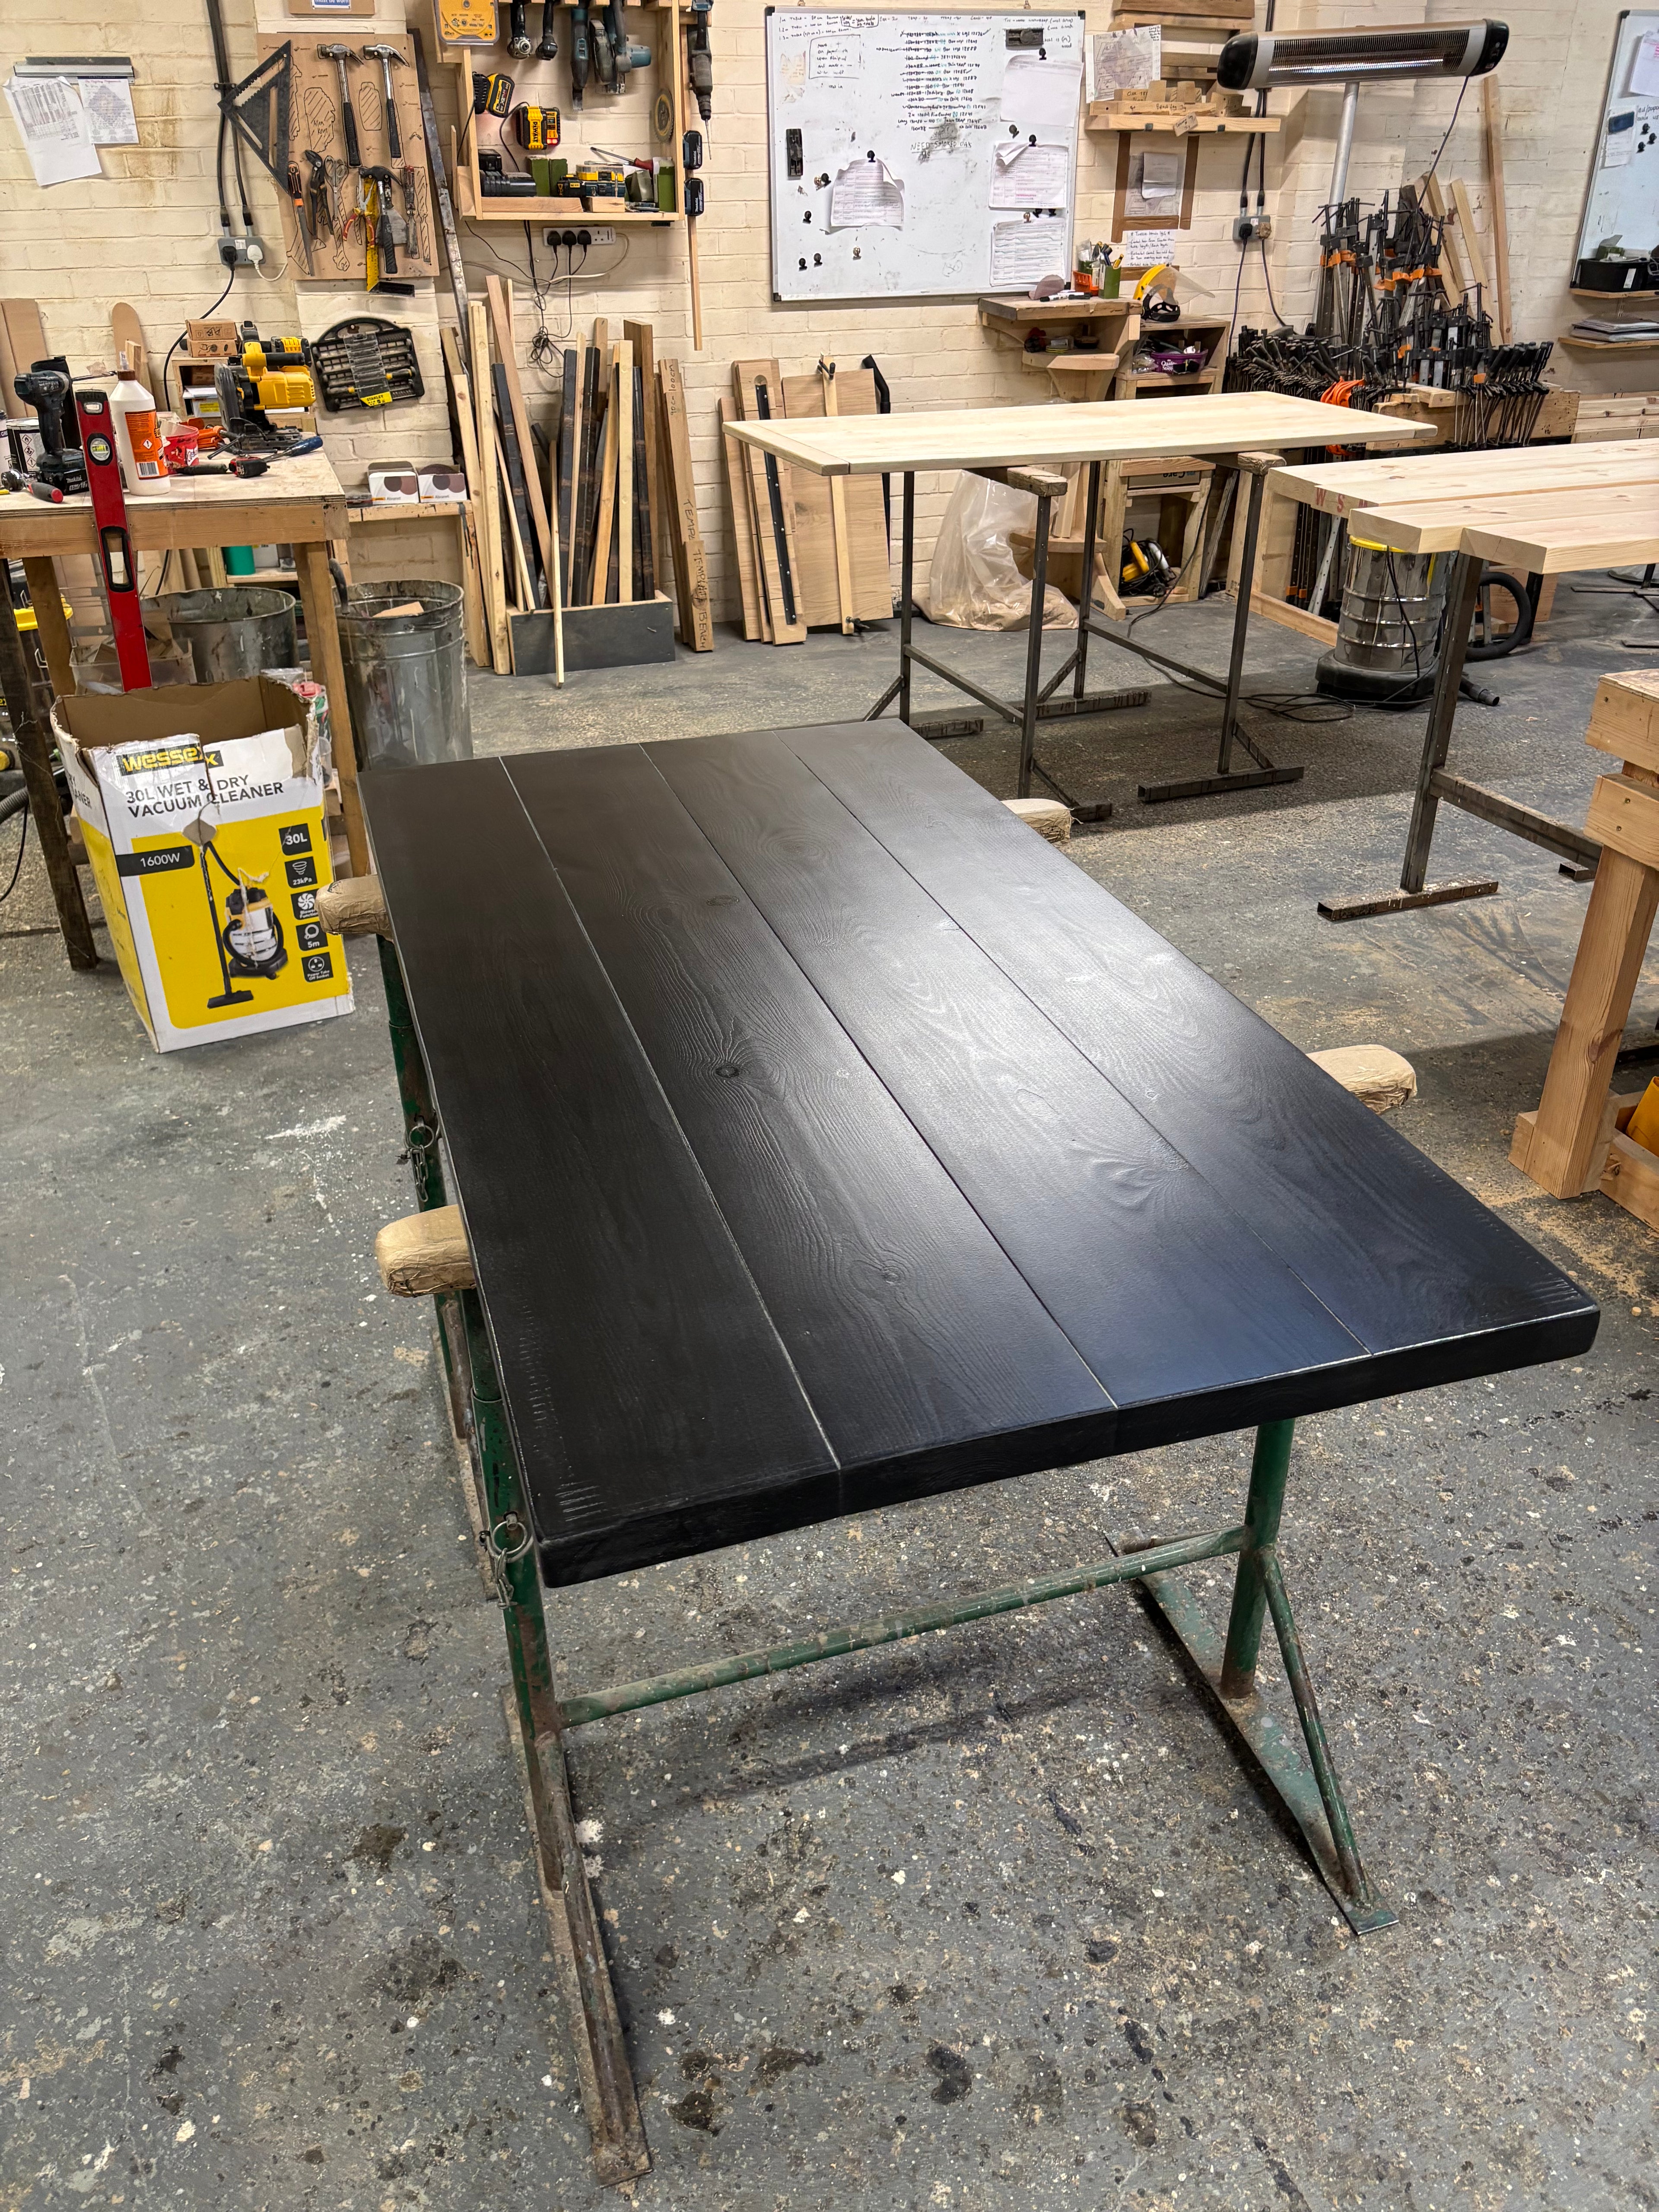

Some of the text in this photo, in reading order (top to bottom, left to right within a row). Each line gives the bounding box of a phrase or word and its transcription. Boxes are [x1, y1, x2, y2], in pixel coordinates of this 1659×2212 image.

[683, 499, 696, 540] TEMPL
[126, 775, 249, 804] 30L WET & DRY
[128, 782, 284, 818] VACUUM CLEANER
[286, 832, 308, 845] 30L
[140, 852, 180, 868] 1600W
[292, 877, 312, 886] 23kPa
